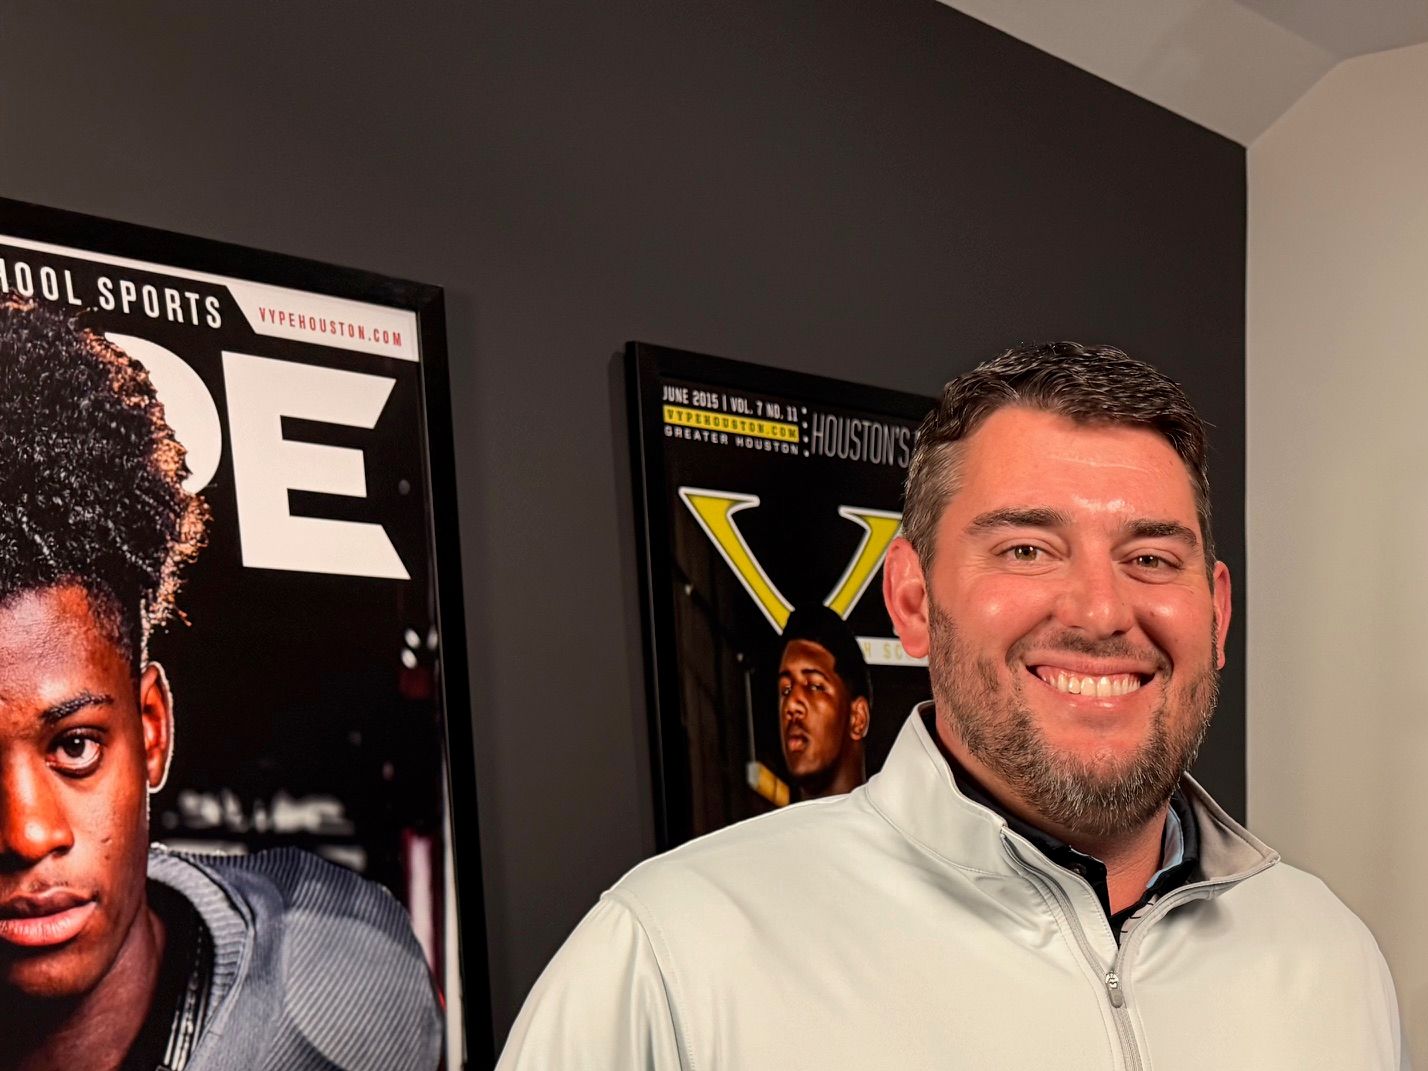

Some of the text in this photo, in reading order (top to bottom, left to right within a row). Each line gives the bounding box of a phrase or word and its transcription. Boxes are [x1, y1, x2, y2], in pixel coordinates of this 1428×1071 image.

[97, 276, 222, 329] SPORTS
[258, 306, 403, 347] VYPEHOUSTON.COM
[662, 385, 799, 422] JUNE 2015 VOL. 7 NO. 11
[664, 425, 799, 456] GREATER HOUSTON
[667, 408, 797, 439] VYPEHOUSTON.COM
[811, 412, 911, 469] HOUSTON'S
